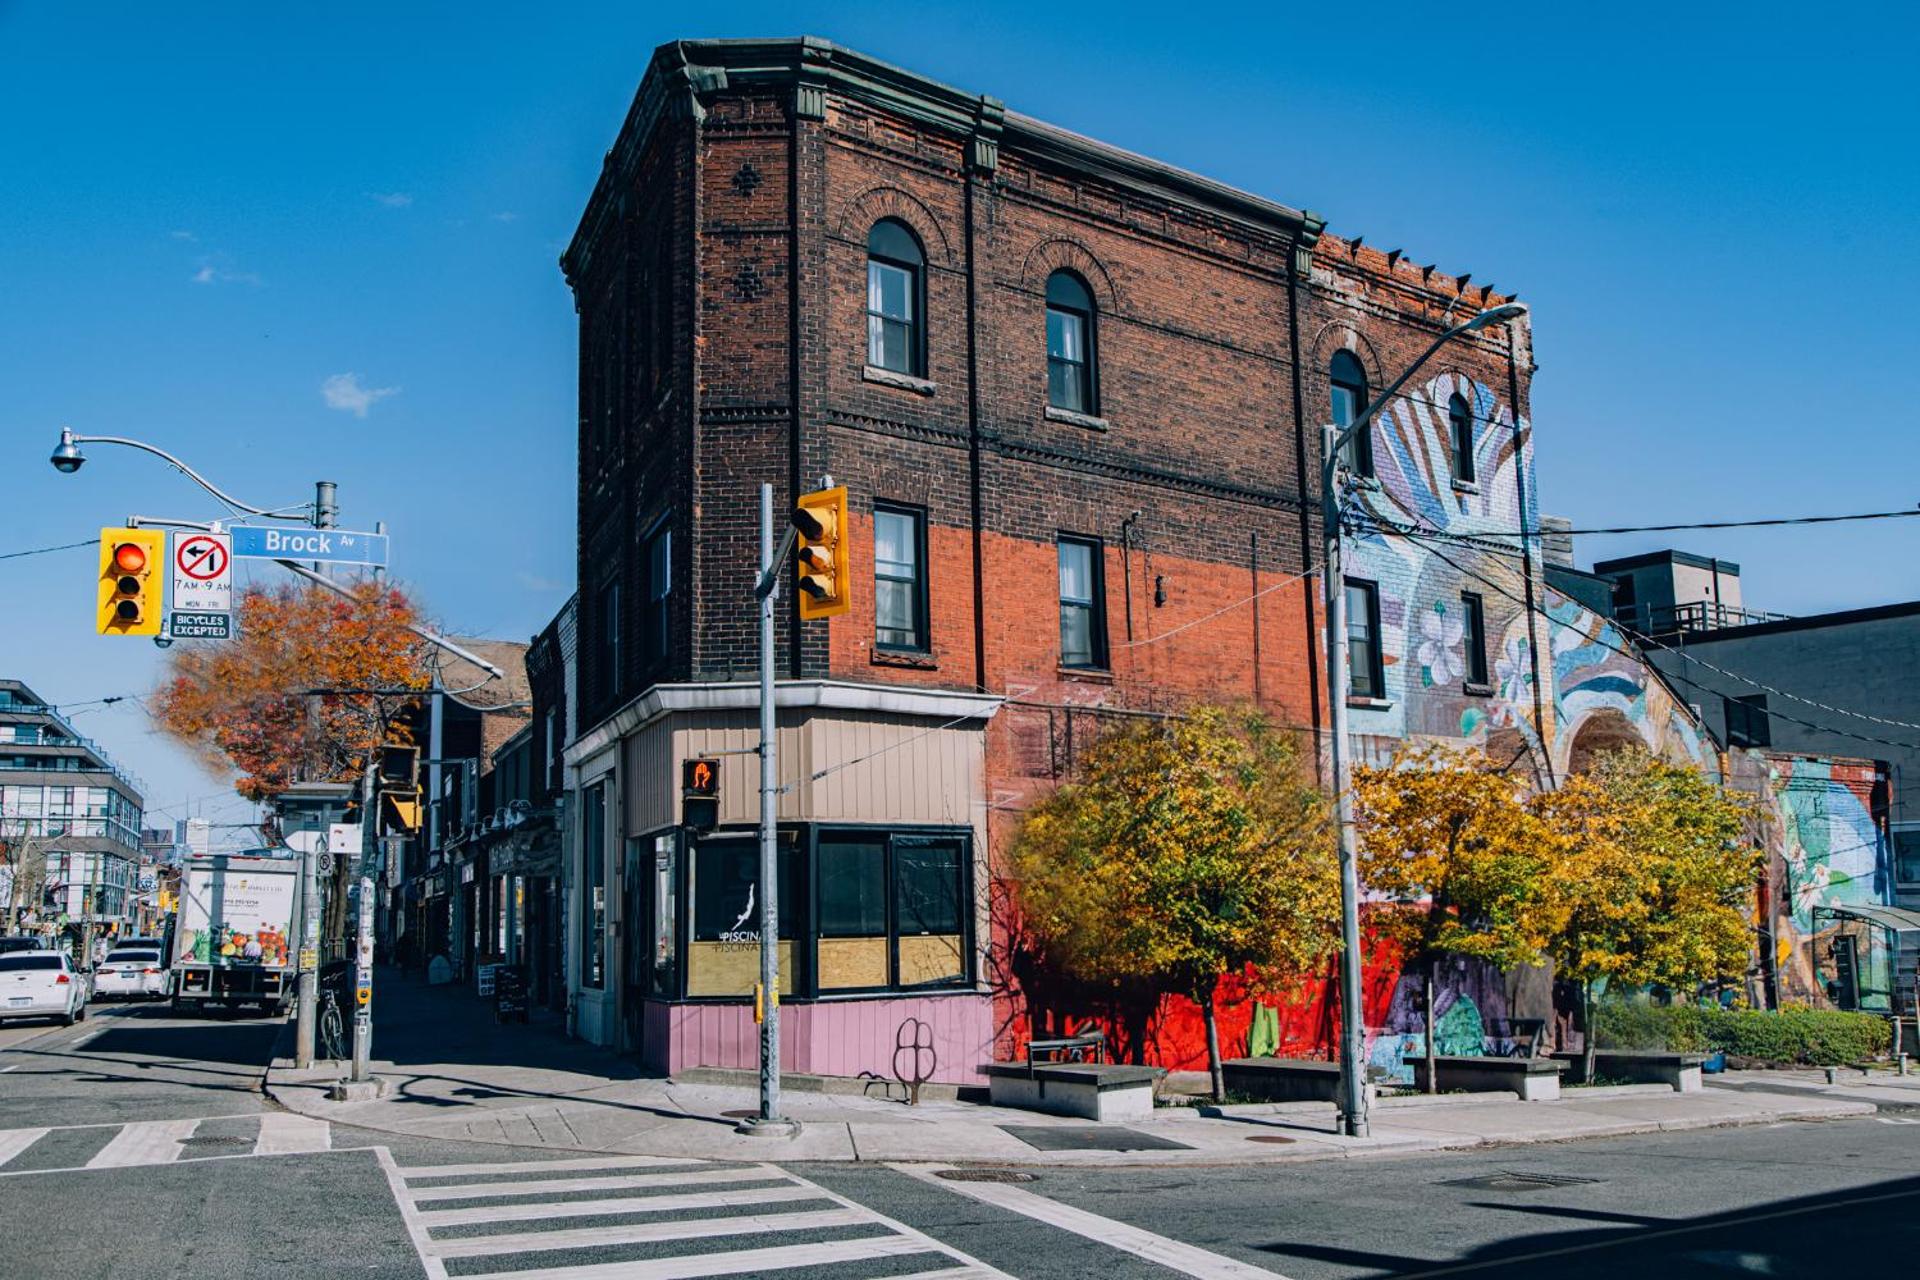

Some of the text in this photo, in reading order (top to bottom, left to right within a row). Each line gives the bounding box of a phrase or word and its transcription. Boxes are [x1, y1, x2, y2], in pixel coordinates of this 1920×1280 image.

[266, 530, 355, 554] Brock Av
[177, 615, 224, 626] BICYCLES
[174, 625, 226, 636] EXCEPTED
[719, 931, 761, 942] PISCIN
